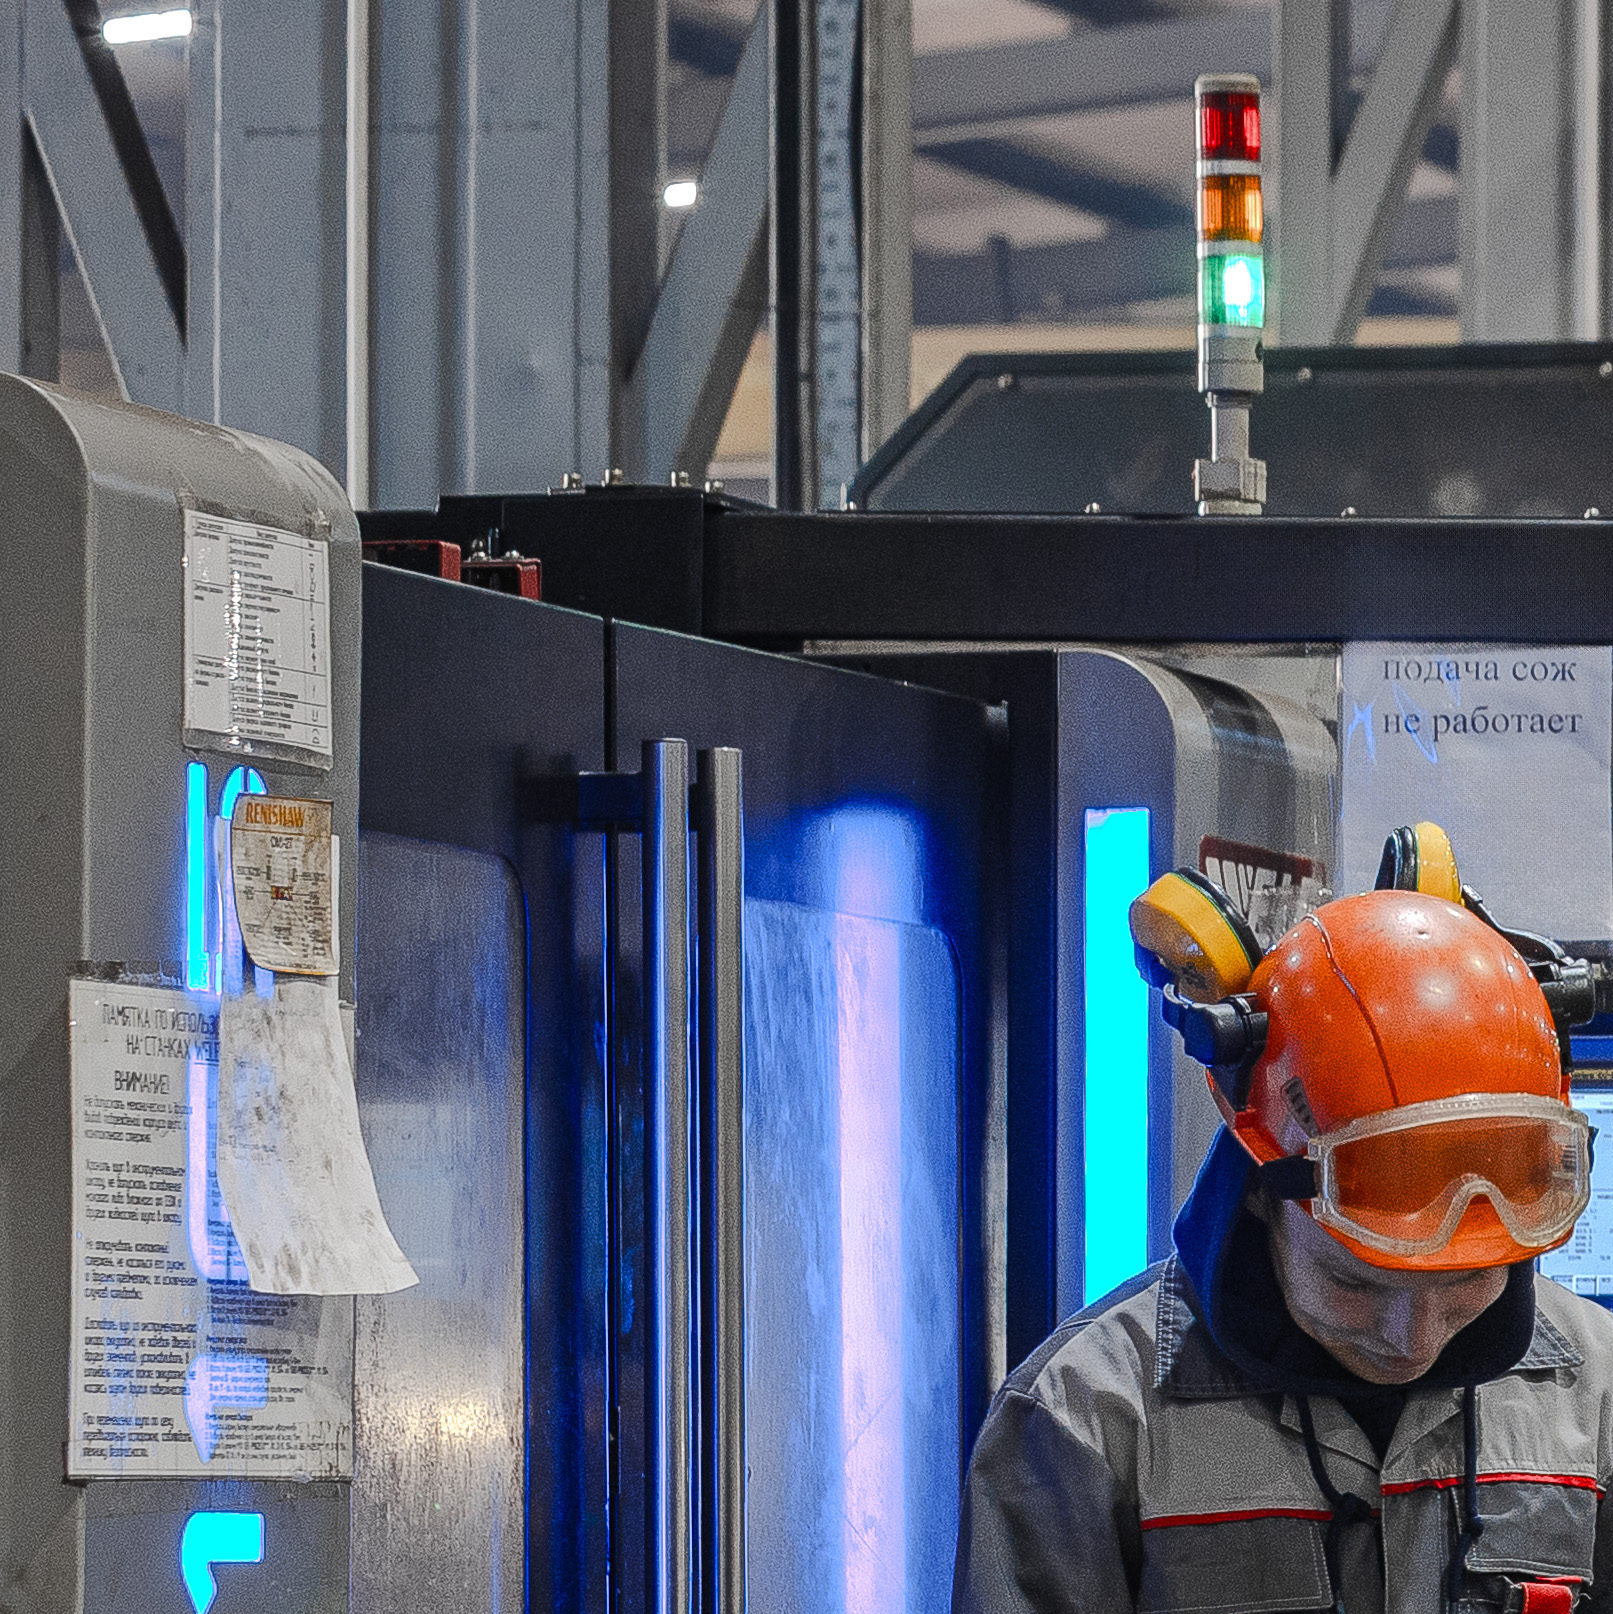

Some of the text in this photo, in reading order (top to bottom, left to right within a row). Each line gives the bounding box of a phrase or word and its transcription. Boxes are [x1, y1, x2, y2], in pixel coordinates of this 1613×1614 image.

[1383, 658, 1577, 684] подача сож
[1383, 706, 1583, 742] не работает
[245, 801, 304, 828] RENISHAW
